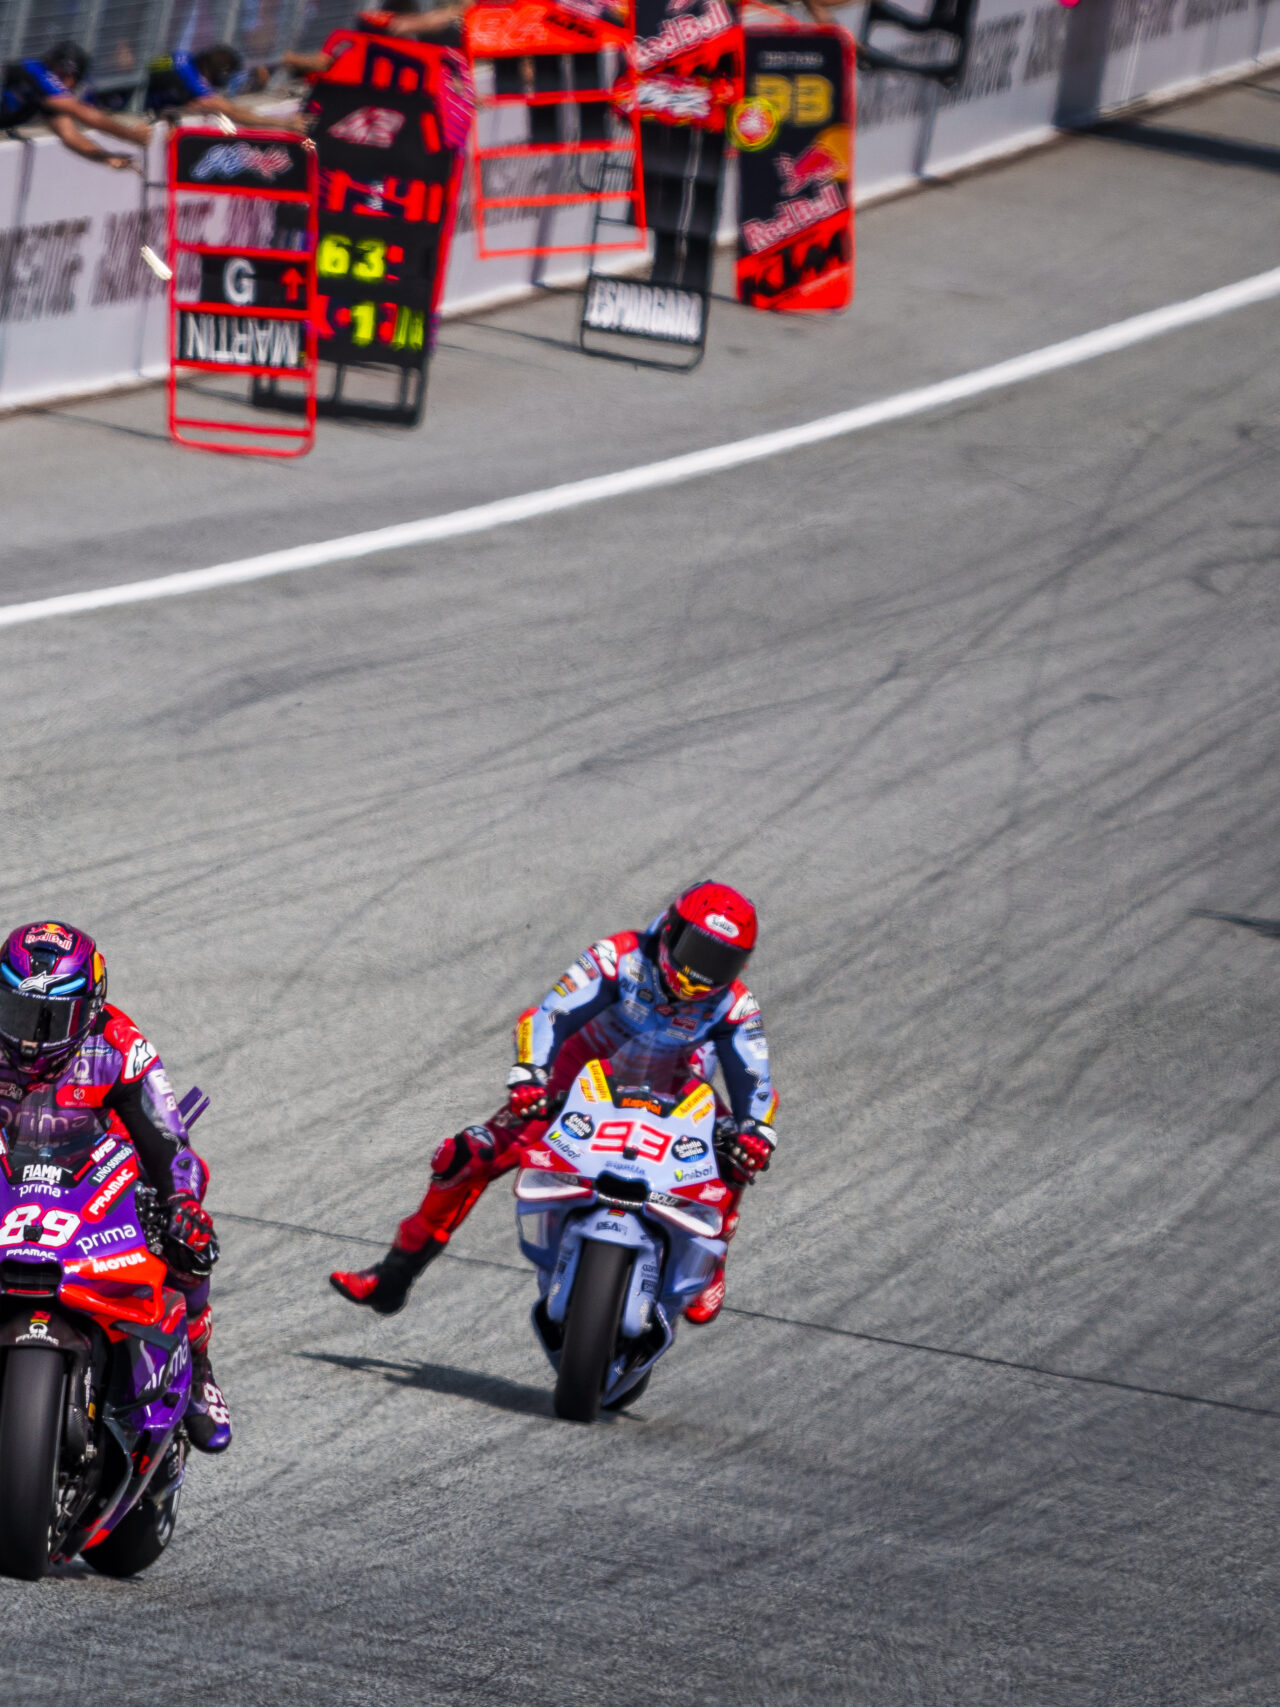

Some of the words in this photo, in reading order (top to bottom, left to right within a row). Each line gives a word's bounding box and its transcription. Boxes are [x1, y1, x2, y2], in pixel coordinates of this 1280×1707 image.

[182, 312, 301, 368] MARTIN
[25, 932, 49, 945] Red
[49, 934, 73, 951] Bull
[91, 1137, 117, 1163] WRS
[590, 1120, 674, 1163] 93
[22, 1163, 63, 1183] FIAMM
[18, 1183, 62, 1198] prima
[88, 1168, 135, 1216] PRAMAC
[75, 1224, 137, 1256] prima
[6, 1248, 54, 1260] PRAMAC
[92, 1252, 147, 1273] MOTUL
